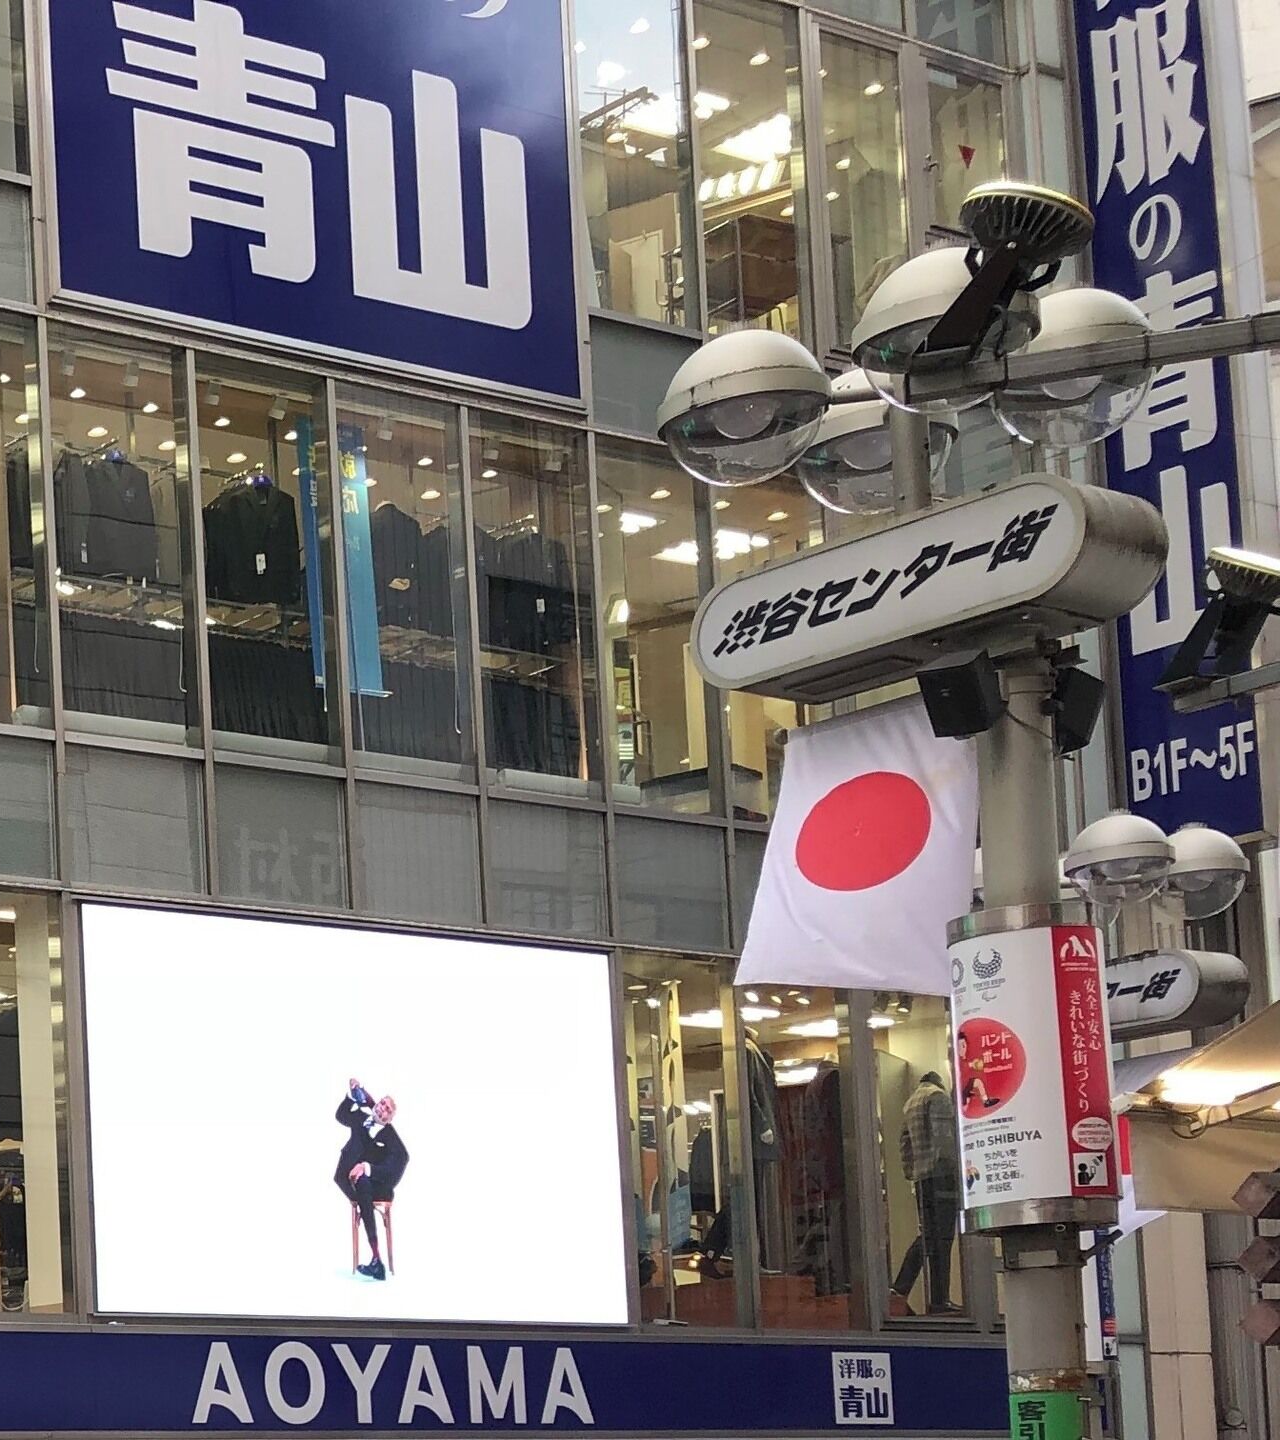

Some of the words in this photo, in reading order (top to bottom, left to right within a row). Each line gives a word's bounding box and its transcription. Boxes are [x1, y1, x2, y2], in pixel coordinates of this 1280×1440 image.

[105, 0, 533, 330] 青山
[1090, 0, 1232, 656] 服の青山
[712, 502, 1060, 658] 渋谷センター街
[1068, 989, 1091, 1113] きれいな街づくり
[987, 1129, 1043, 1147] SHIBUYA
[191, 1340, 595, 1425] AOYAMA
[838, 1358, 886, 1380] 洋服の
[838, 1384, 890, 1419] 青山
